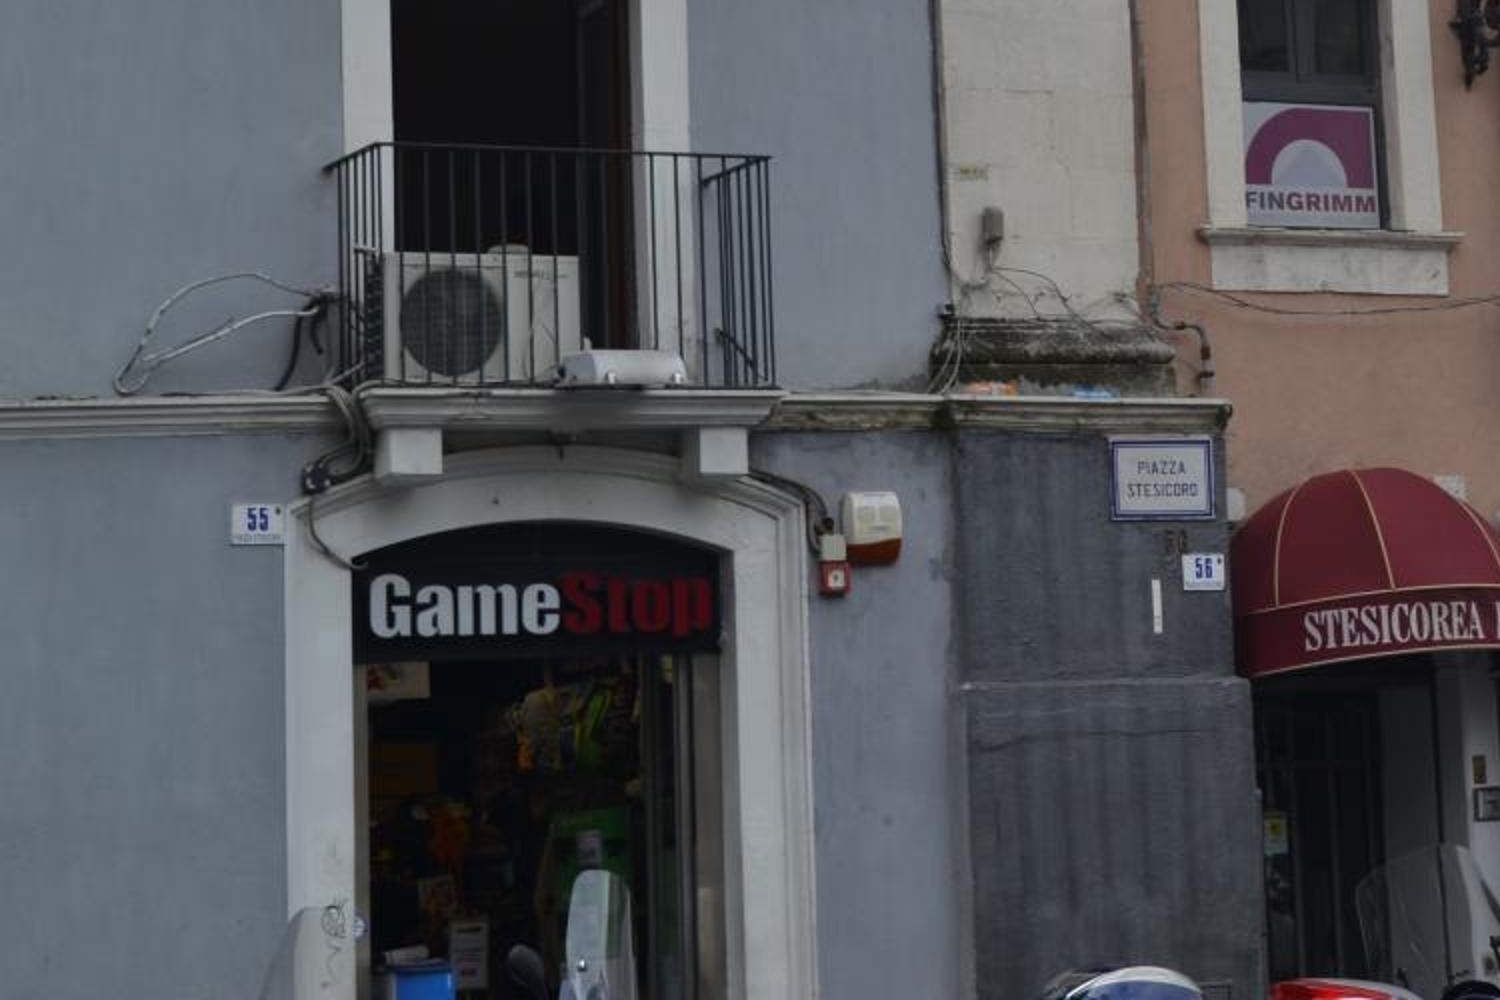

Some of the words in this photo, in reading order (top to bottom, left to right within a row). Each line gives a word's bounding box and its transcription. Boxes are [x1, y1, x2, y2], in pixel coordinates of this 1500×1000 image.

[1246, 191, 1377, 213] FINGRIMM
[1137, 459, 1187, 475] PIAZZA
[1127, 482, 1199, 498] STESICORO
[247, 507, 269, 532] 55
[1195, 557, 1213, 579] 56
[369, 571, 713, 639] GameStop
[1304, 600, 1486, 652] STESICOREA
